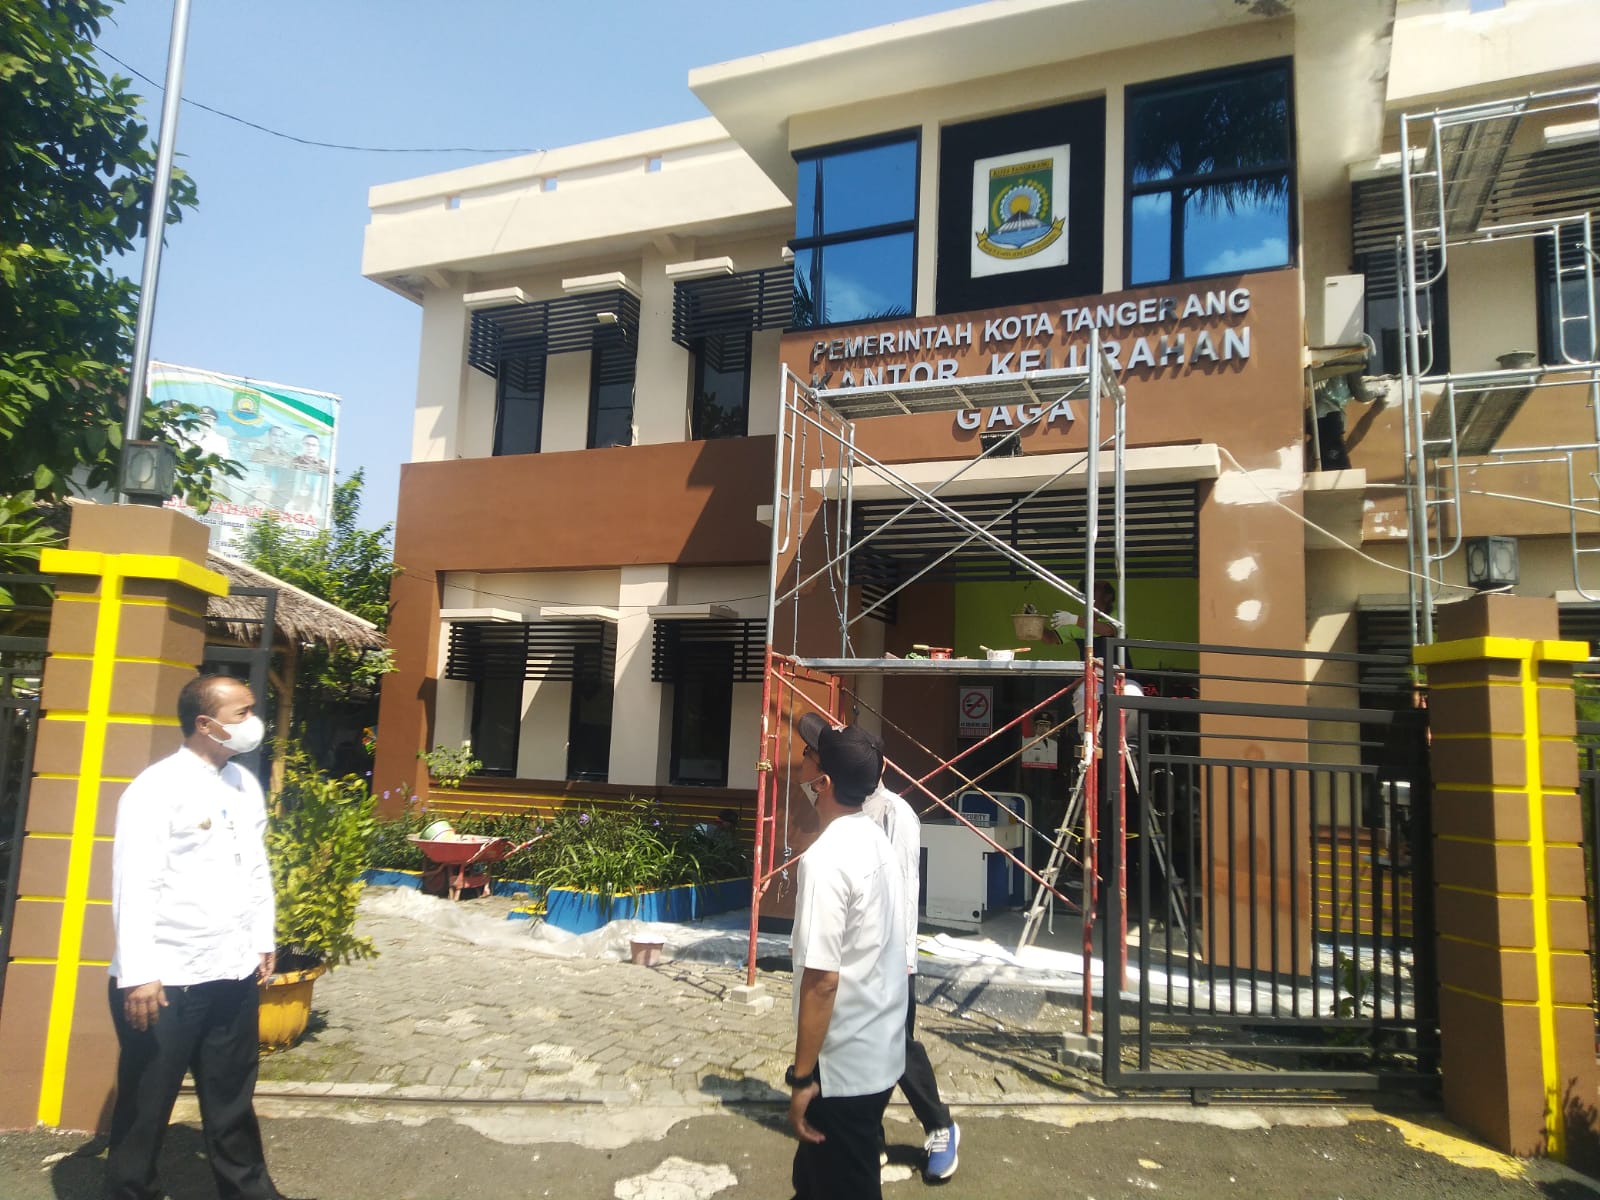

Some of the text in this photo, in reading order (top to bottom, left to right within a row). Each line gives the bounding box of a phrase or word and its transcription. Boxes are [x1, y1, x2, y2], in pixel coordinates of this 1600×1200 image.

[812, 287, 1251, 362] PEMERINTAH KOTA TANGERANG
[811, 358, 959, 391] KANTOR
[957, 399, 1075, 430] GAGA
